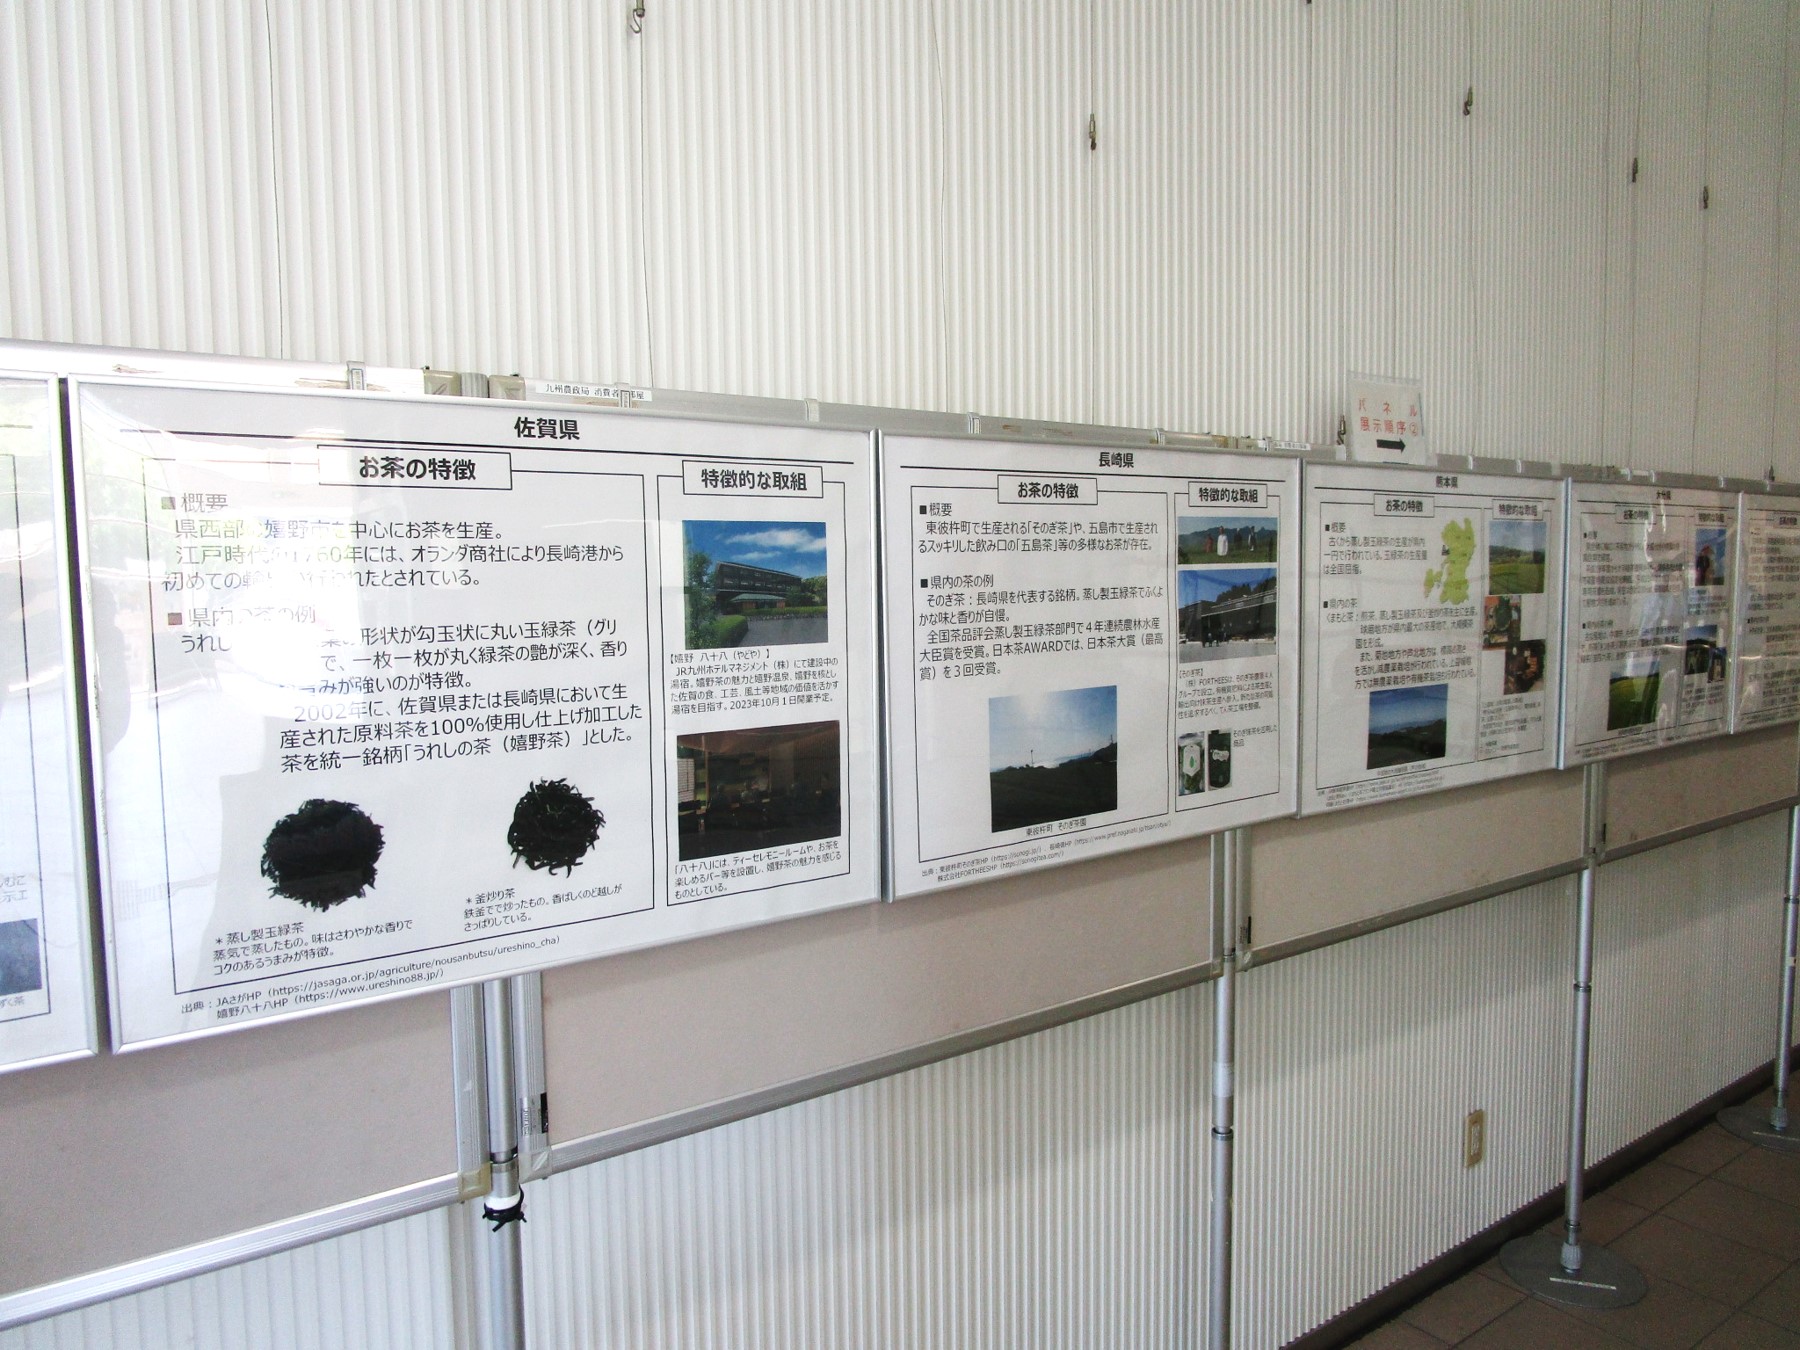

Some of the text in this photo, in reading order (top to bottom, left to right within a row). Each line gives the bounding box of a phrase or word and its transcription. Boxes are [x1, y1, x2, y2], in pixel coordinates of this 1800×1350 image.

[594, 388, 645, 400] 消費者部屋
[514, 417, 581, 440] 佐賀県
[1360, 417, 1418, 437] 展示順序②
[359, 456, 476, 481] お茶の特徴
[1098, 452, 1135, 468] 長崎県
[701, 468, 808, 491] 特徴的な取組
[1435, 475, 1458, 488] 熊本県
[1017, 482, 1079, 499] お茶の特徴
[1198, 487, 1258, 503] 特徴的な取組
[180, 493, 229, 513] 概要
[929, 502, 952, 516] 概要
[1386, 500, 1423, 513] お茶の特徴
[930, 574, 994, 590] 県内の茶の例
[300, 670, 472, 696] みが強いのが特徴。
[279, 704, 643, 750] 産された原料茶を100%使用し仕上げ加工した
